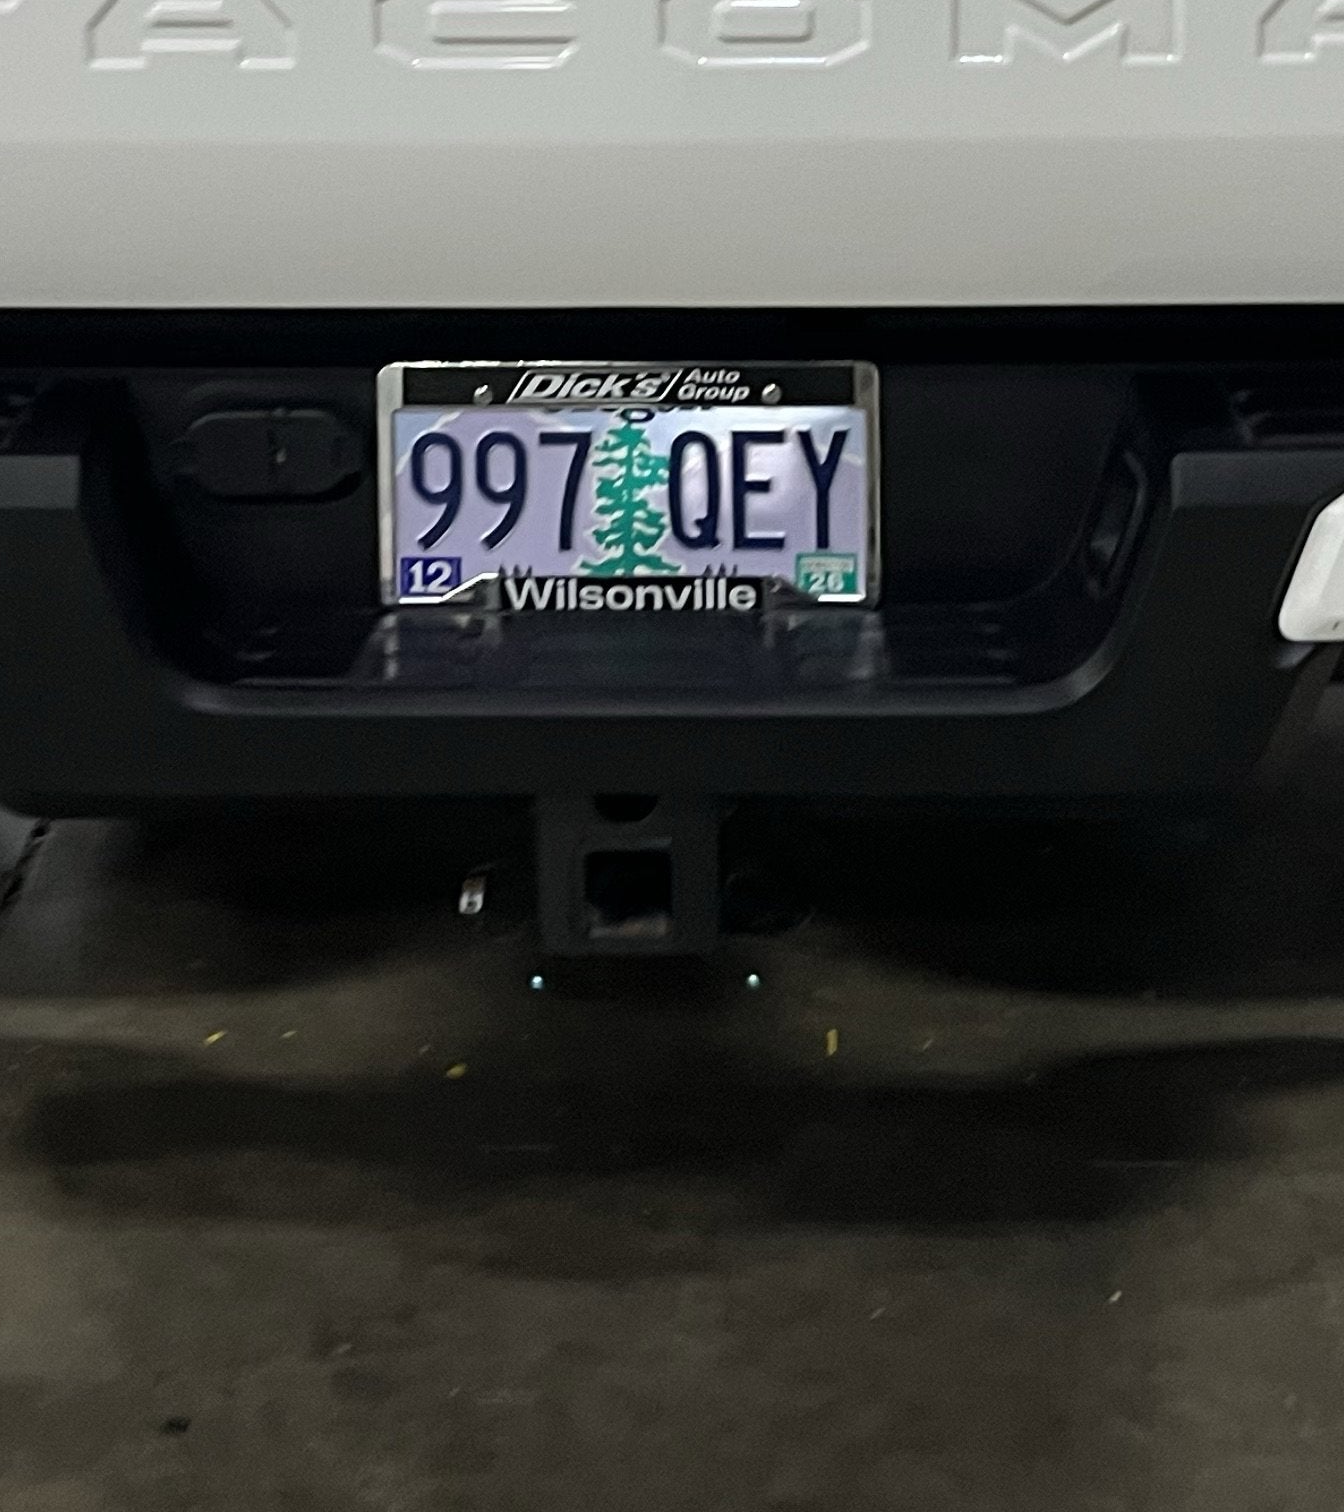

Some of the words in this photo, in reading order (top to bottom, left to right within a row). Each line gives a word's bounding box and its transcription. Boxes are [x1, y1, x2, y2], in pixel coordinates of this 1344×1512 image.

[519, 371, 658, 400] Dick's
[684, 368, 742, 384] Auto
[677, 382, 751, 402] Group
[410, 430, 593, 552] 997
[668, 430, 850, 552] QEY
[407, 560, 454, 594] 12
[503, 576, 757, 612] Wilsonville
